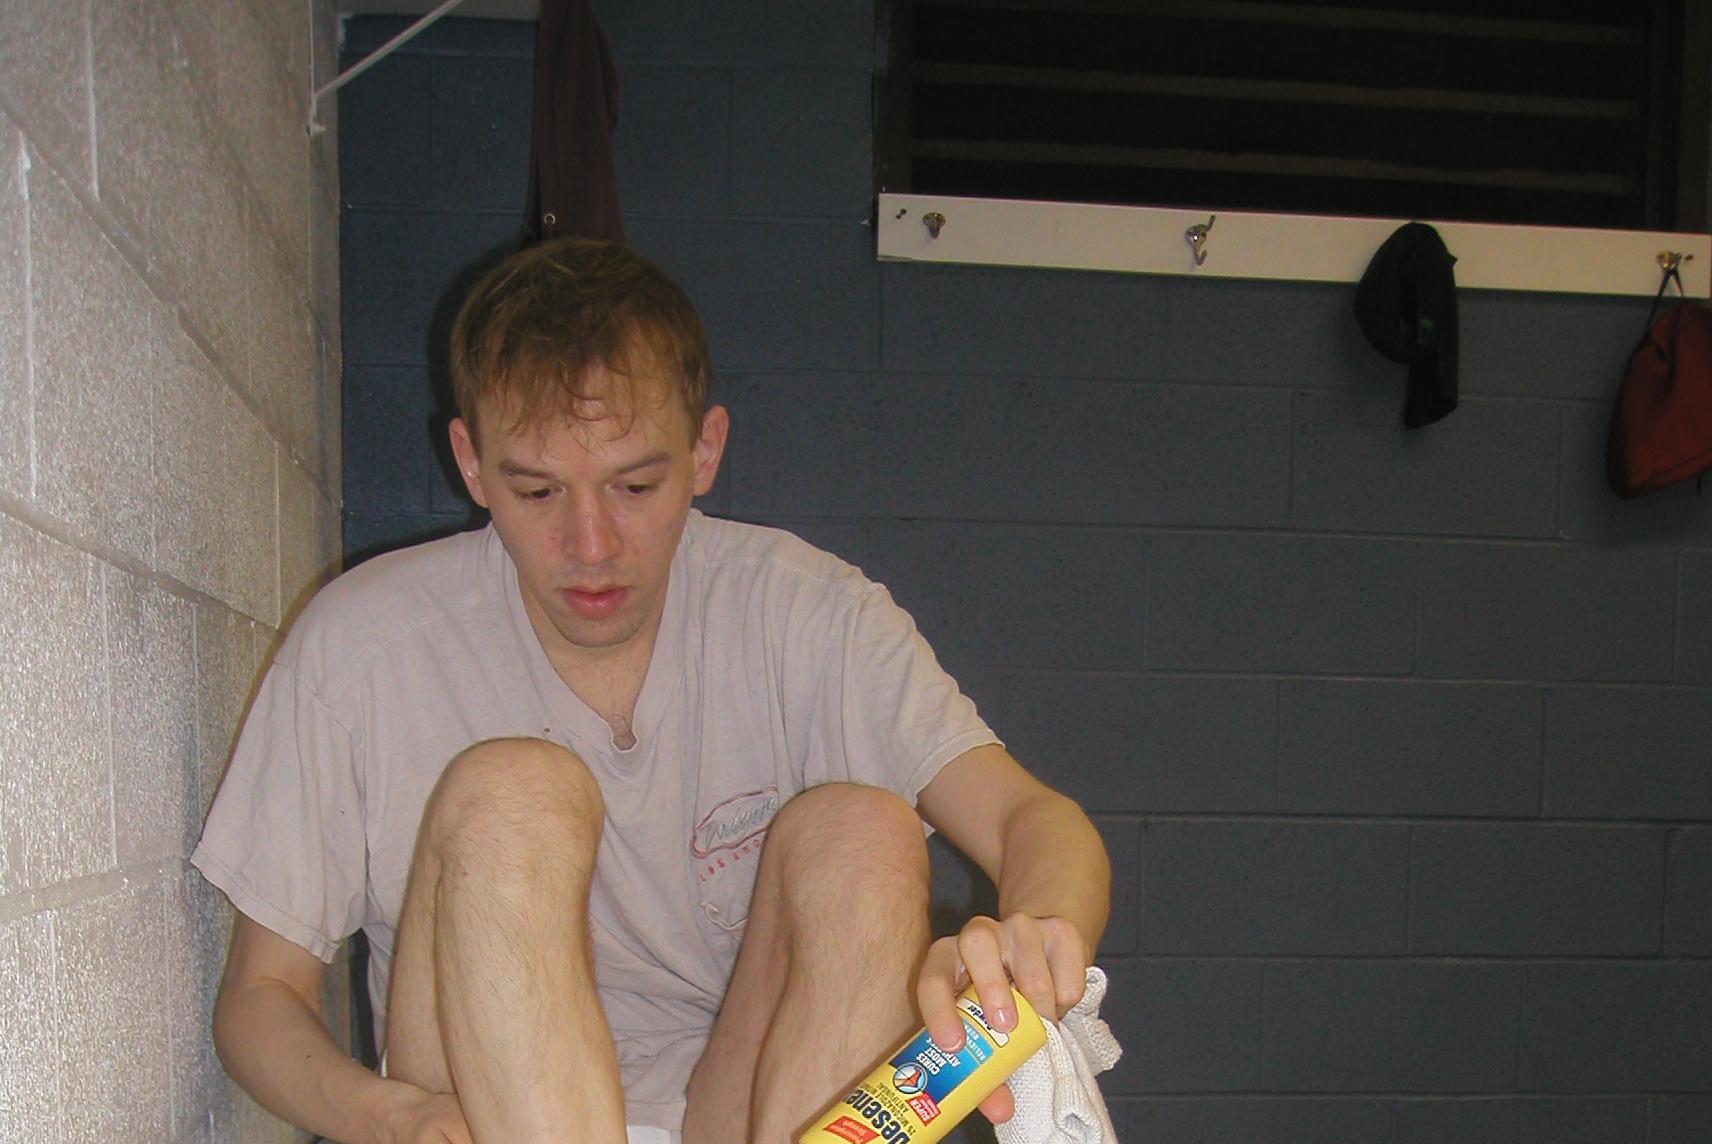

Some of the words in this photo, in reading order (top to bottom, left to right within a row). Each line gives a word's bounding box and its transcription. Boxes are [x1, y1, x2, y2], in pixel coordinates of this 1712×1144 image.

[915, 1052, 941, 1076] CURES
[924, 1047, 948, 1068] MOST
[909, 1098, 931, 1122] SUPER
